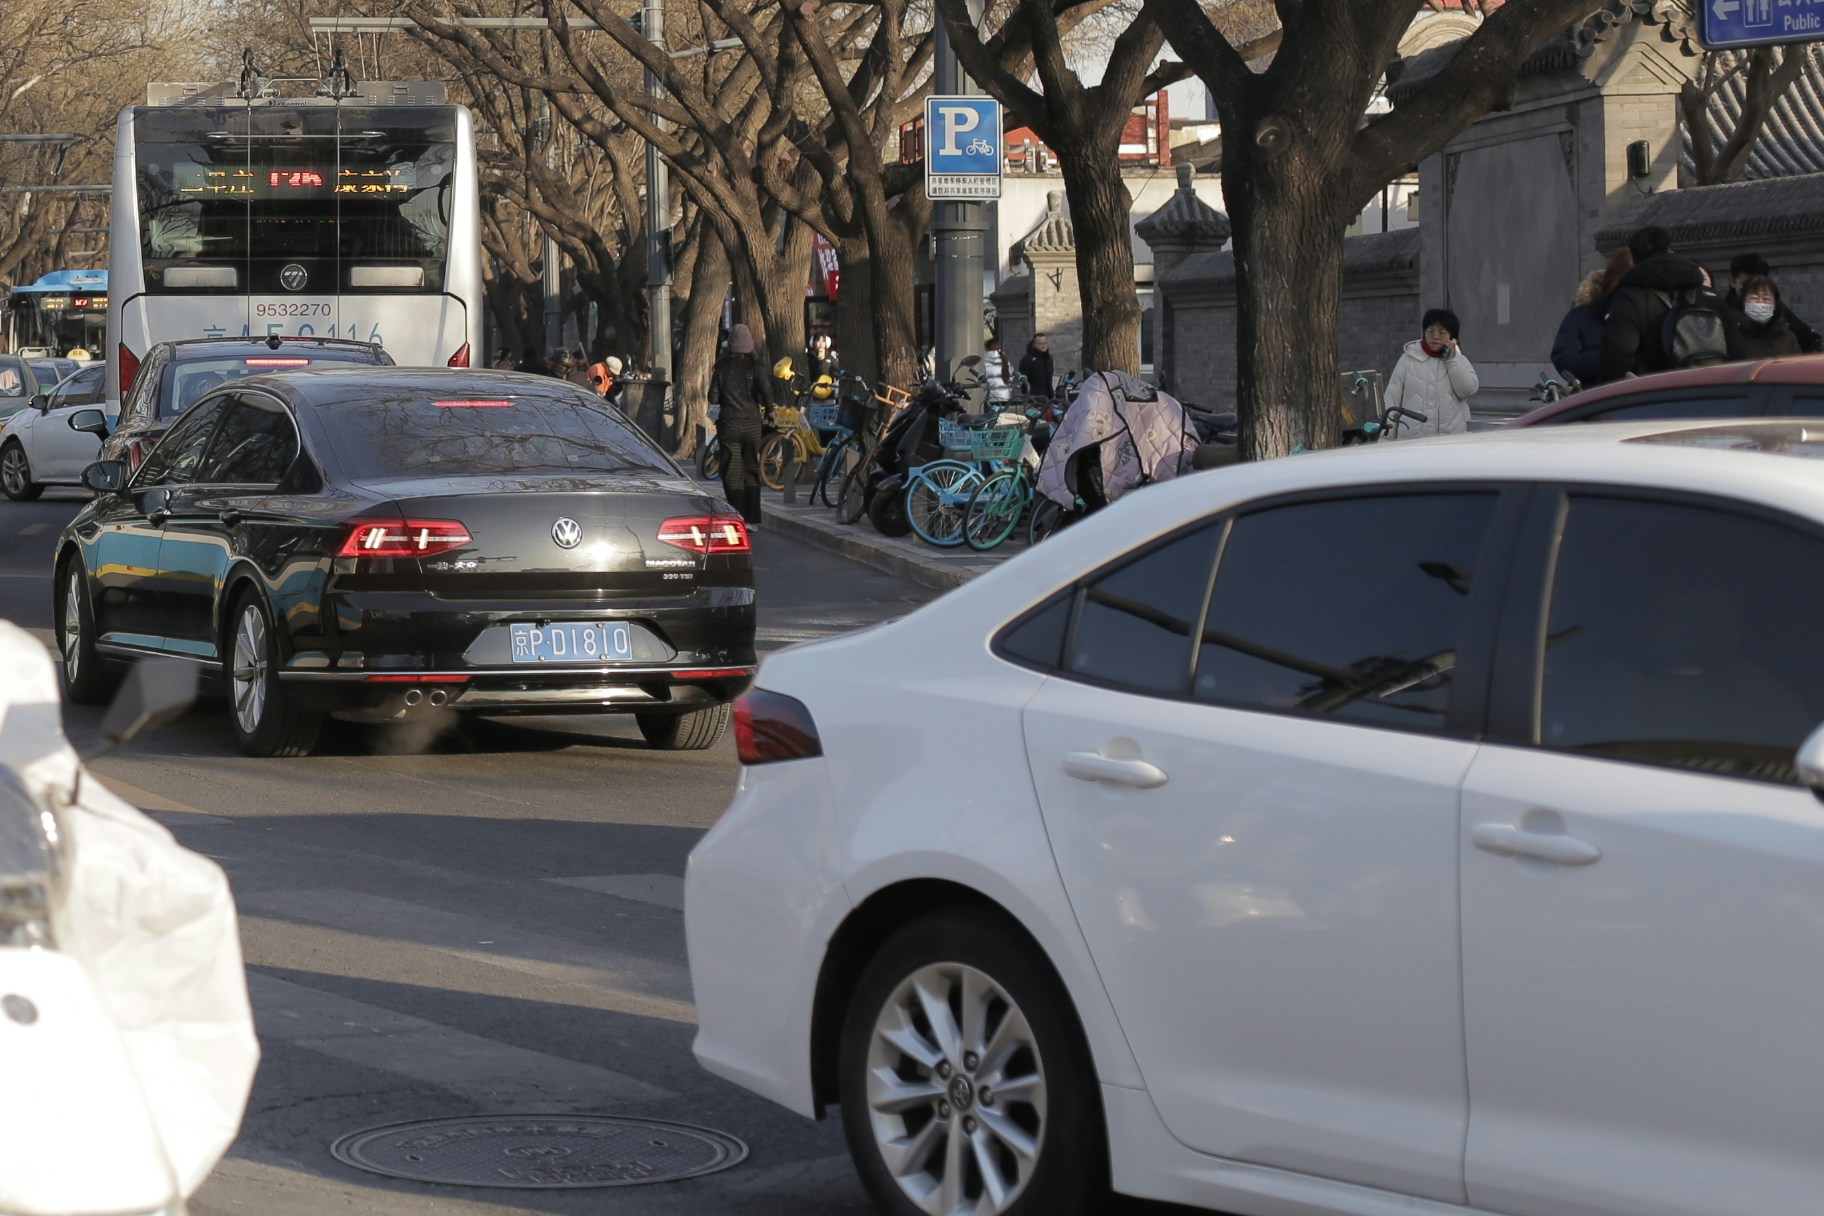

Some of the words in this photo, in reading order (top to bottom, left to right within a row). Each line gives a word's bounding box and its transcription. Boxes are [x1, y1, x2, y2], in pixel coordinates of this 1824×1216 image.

[1784, 12, 1821, 32] Public
[939, 107, 979, 155] P
[256, 303, 331, 317] 9532270
